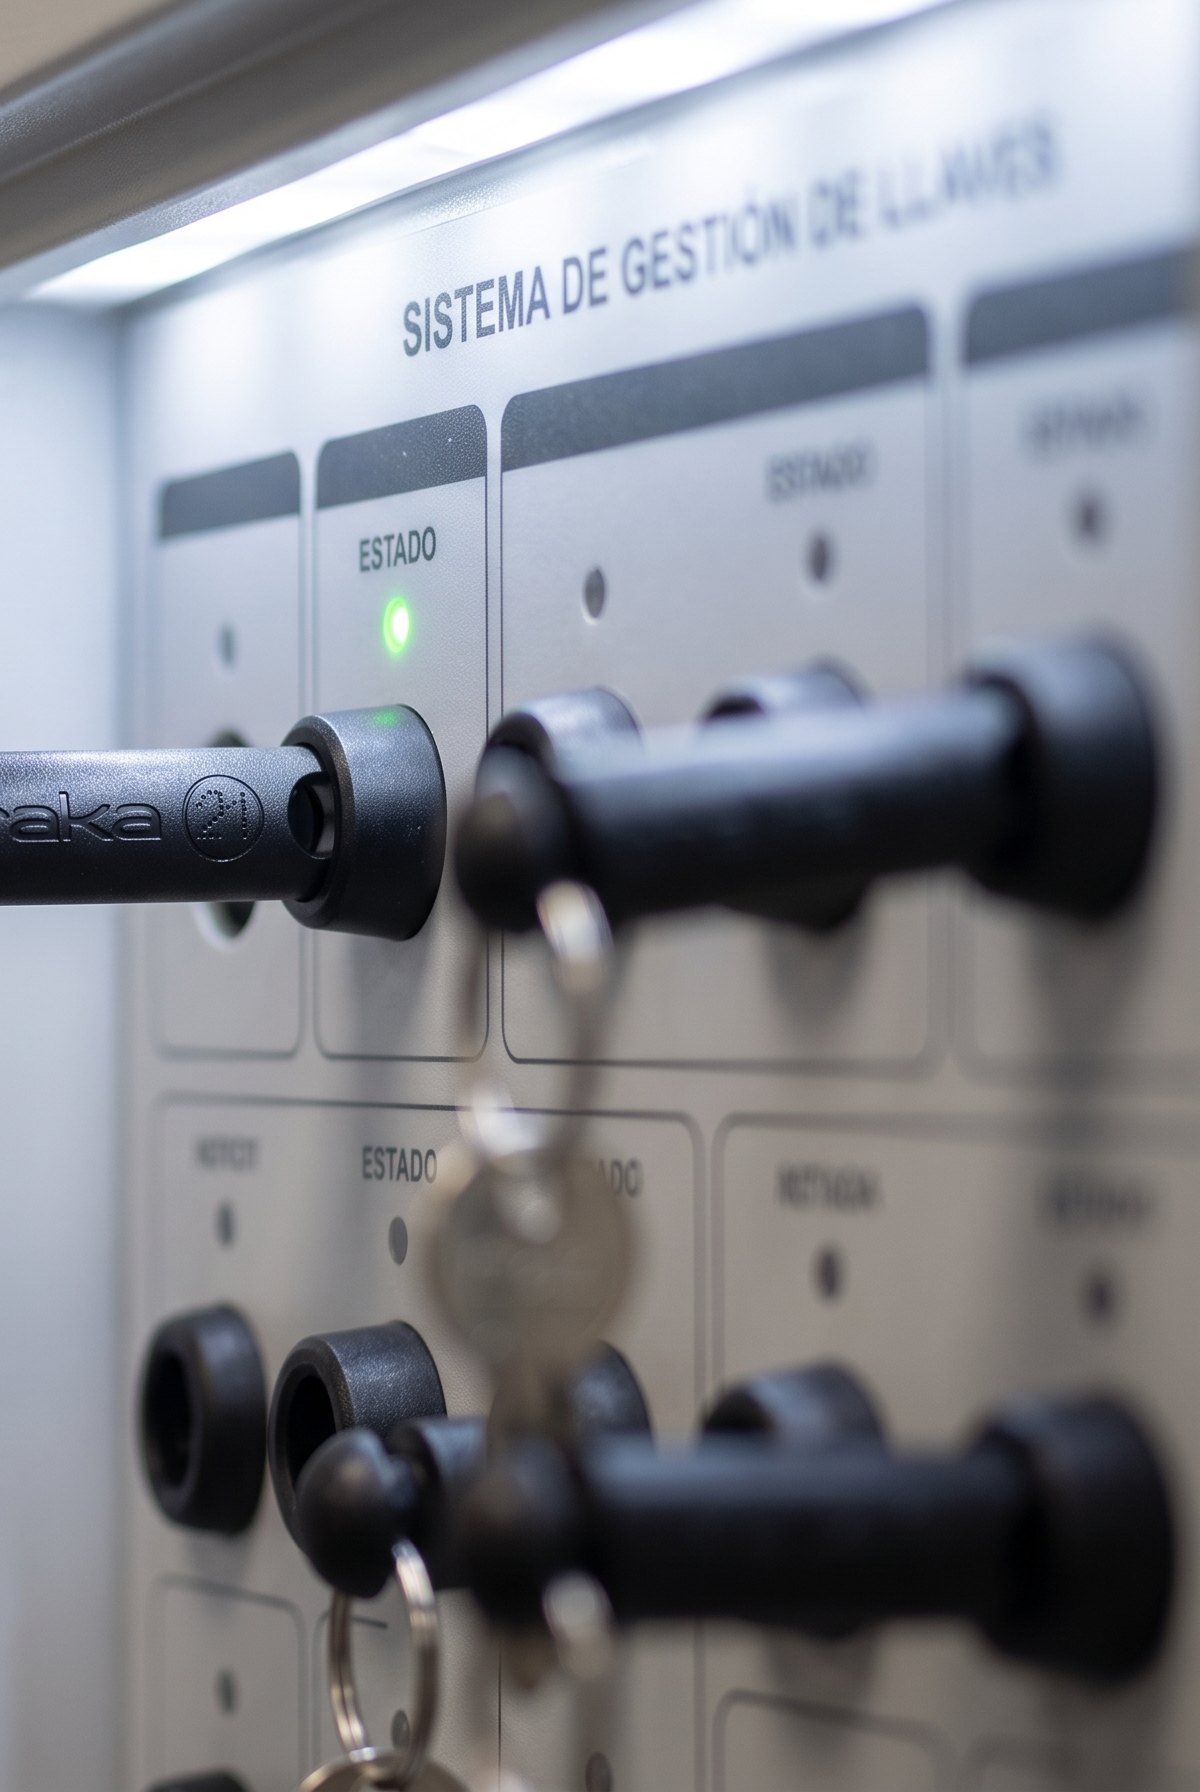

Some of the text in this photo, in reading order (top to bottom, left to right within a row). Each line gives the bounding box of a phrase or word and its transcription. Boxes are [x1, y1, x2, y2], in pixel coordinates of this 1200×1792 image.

[402, 264, 552, 358] SISTEMA
[561, 246, 608, 316] DE
[620, 184, 796, 297] GESTIÓN
[808, 168, 864, 249] DE
[358, 526, 437, 573] ESTADO
[362, 1146, 438, 1184] ESTADO
